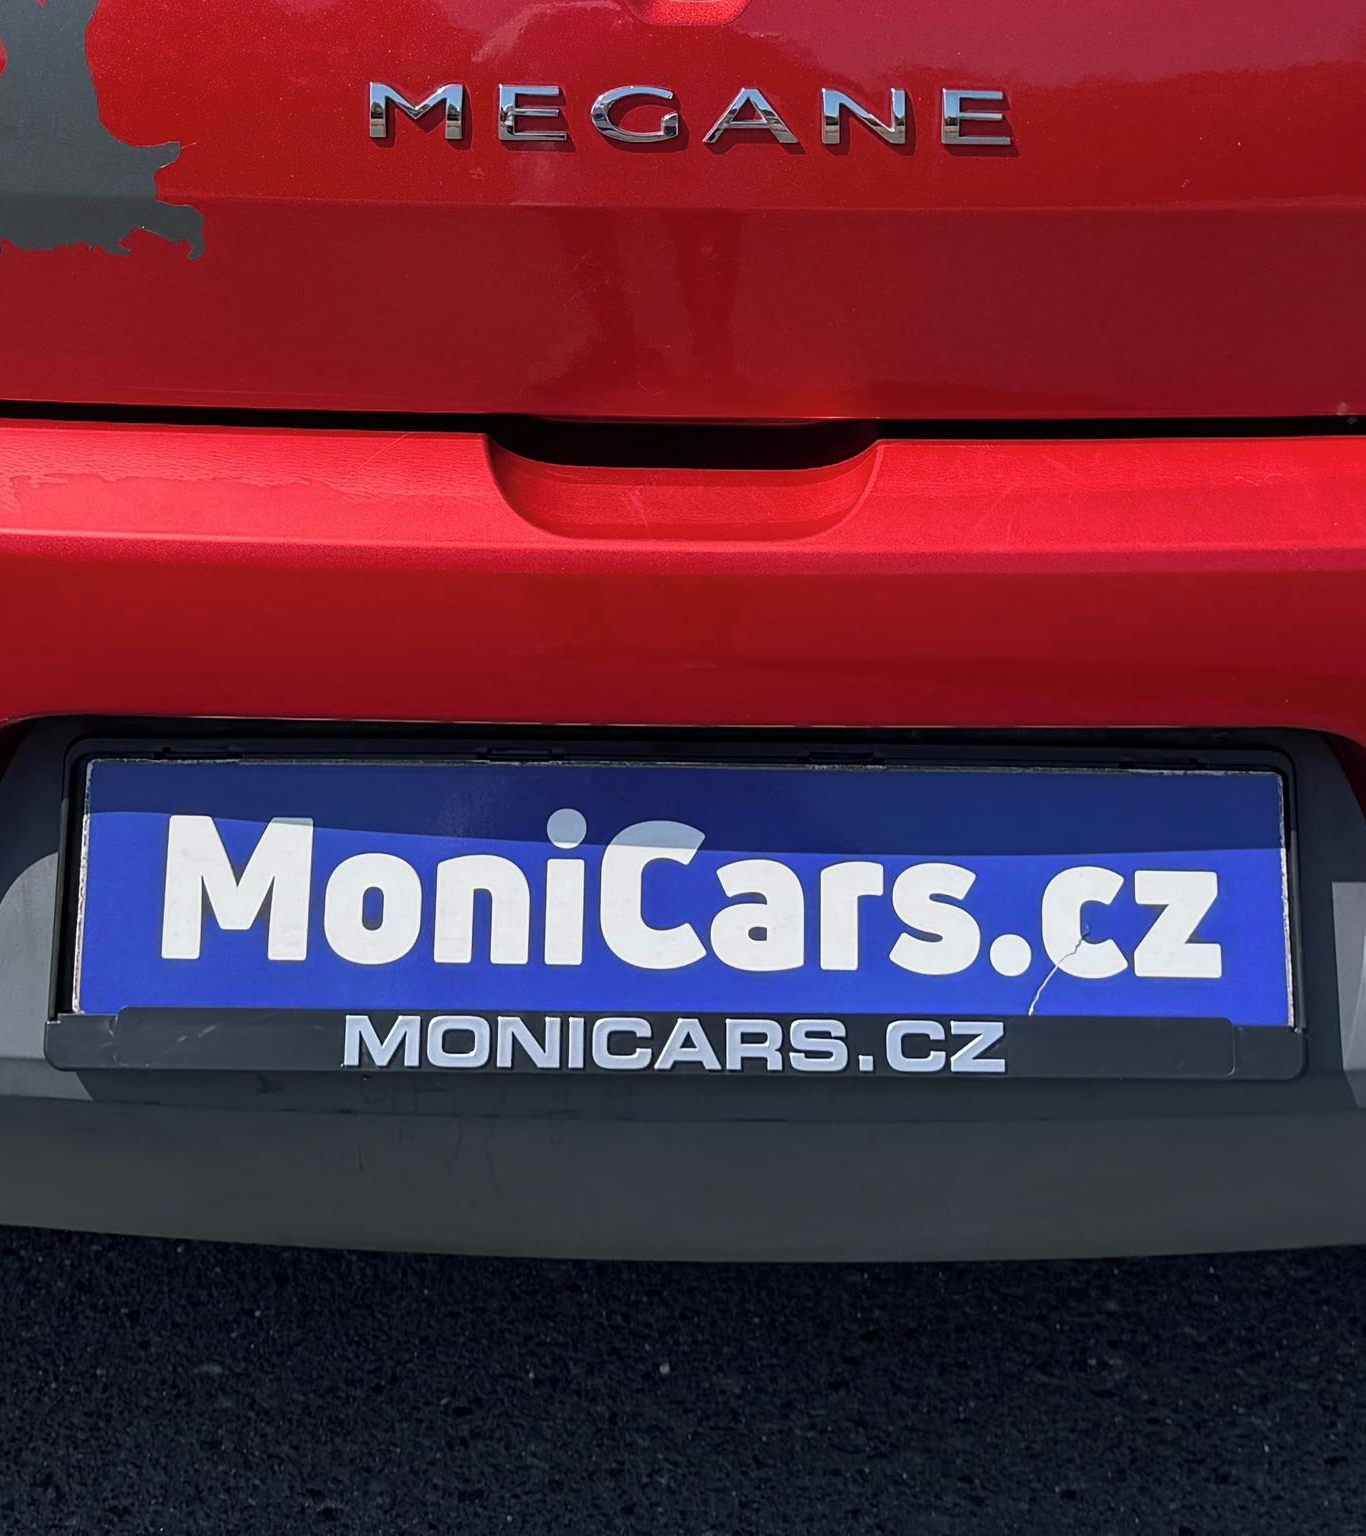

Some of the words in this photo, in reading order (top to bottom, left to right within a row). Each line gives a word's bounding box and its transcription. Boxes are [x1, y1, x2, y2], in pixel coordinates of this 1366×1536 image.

[369, 81, 1012, 146] MEGANE
[161, 807, 1223, 979] MoniCars.cz
[344, 1015, 1007, 1073] MONICARS.CZ
